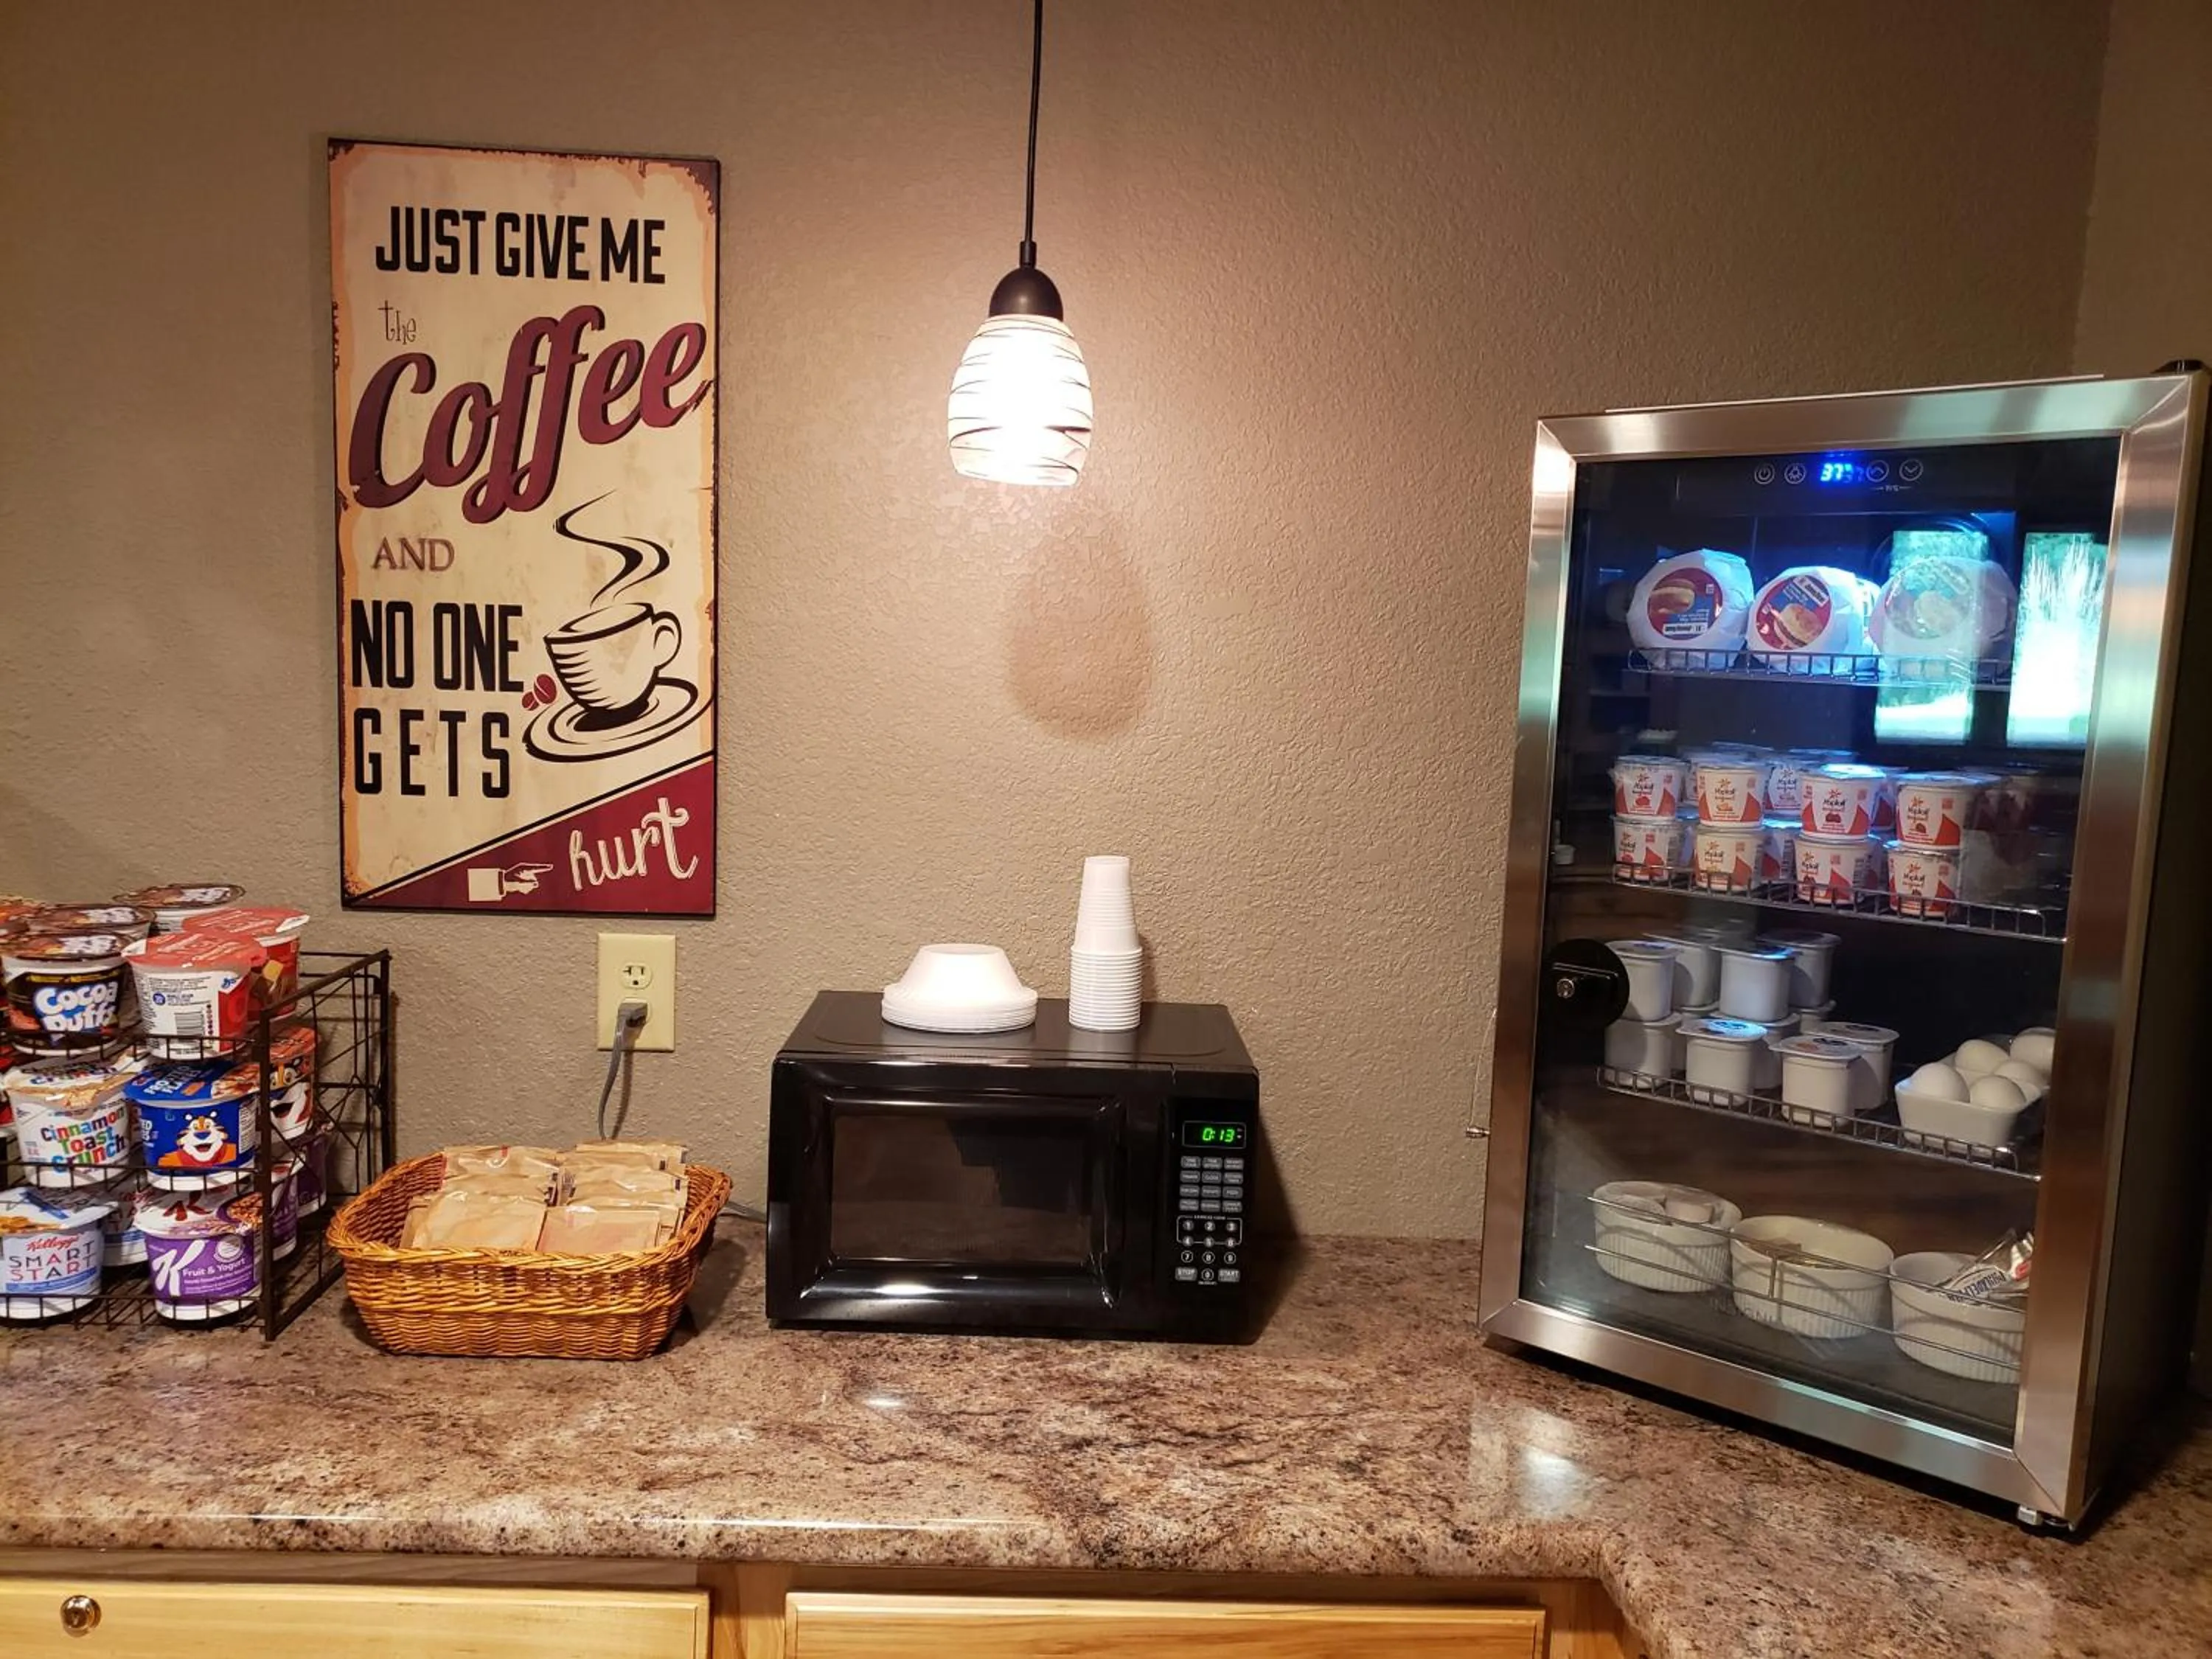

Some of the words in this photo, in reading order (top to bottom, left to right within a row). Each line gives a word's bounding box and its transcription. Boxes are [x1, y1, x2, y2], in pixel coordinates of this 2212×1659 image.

[375, 206, 486, 275] JUST
[495, 212, 590, 281] GIVE
[600, 218, 666, 285] ME
[378, 300, 417, 344] the
[348, 305, 714, 524] Coffee
[372, 537, 455, 572] AND
[350, 599, 414, 688] NO
[433, 602, 524, 692] ONE
[354, 708, 510, 799] GETS
[568, 797, 698, 891] hurt
[35, 981, 118, 1015] Cocoa
[1202, 1127, 1235, 1142] 0:13
[9, 1240, 95, 1268] SMART
[10, 1253, 97, 1281] START
[183, 1267, 206, 1277] Fruit
[207, 1266, 215, 1275] &
[217, 1258, 246, 1272] Yogurt
